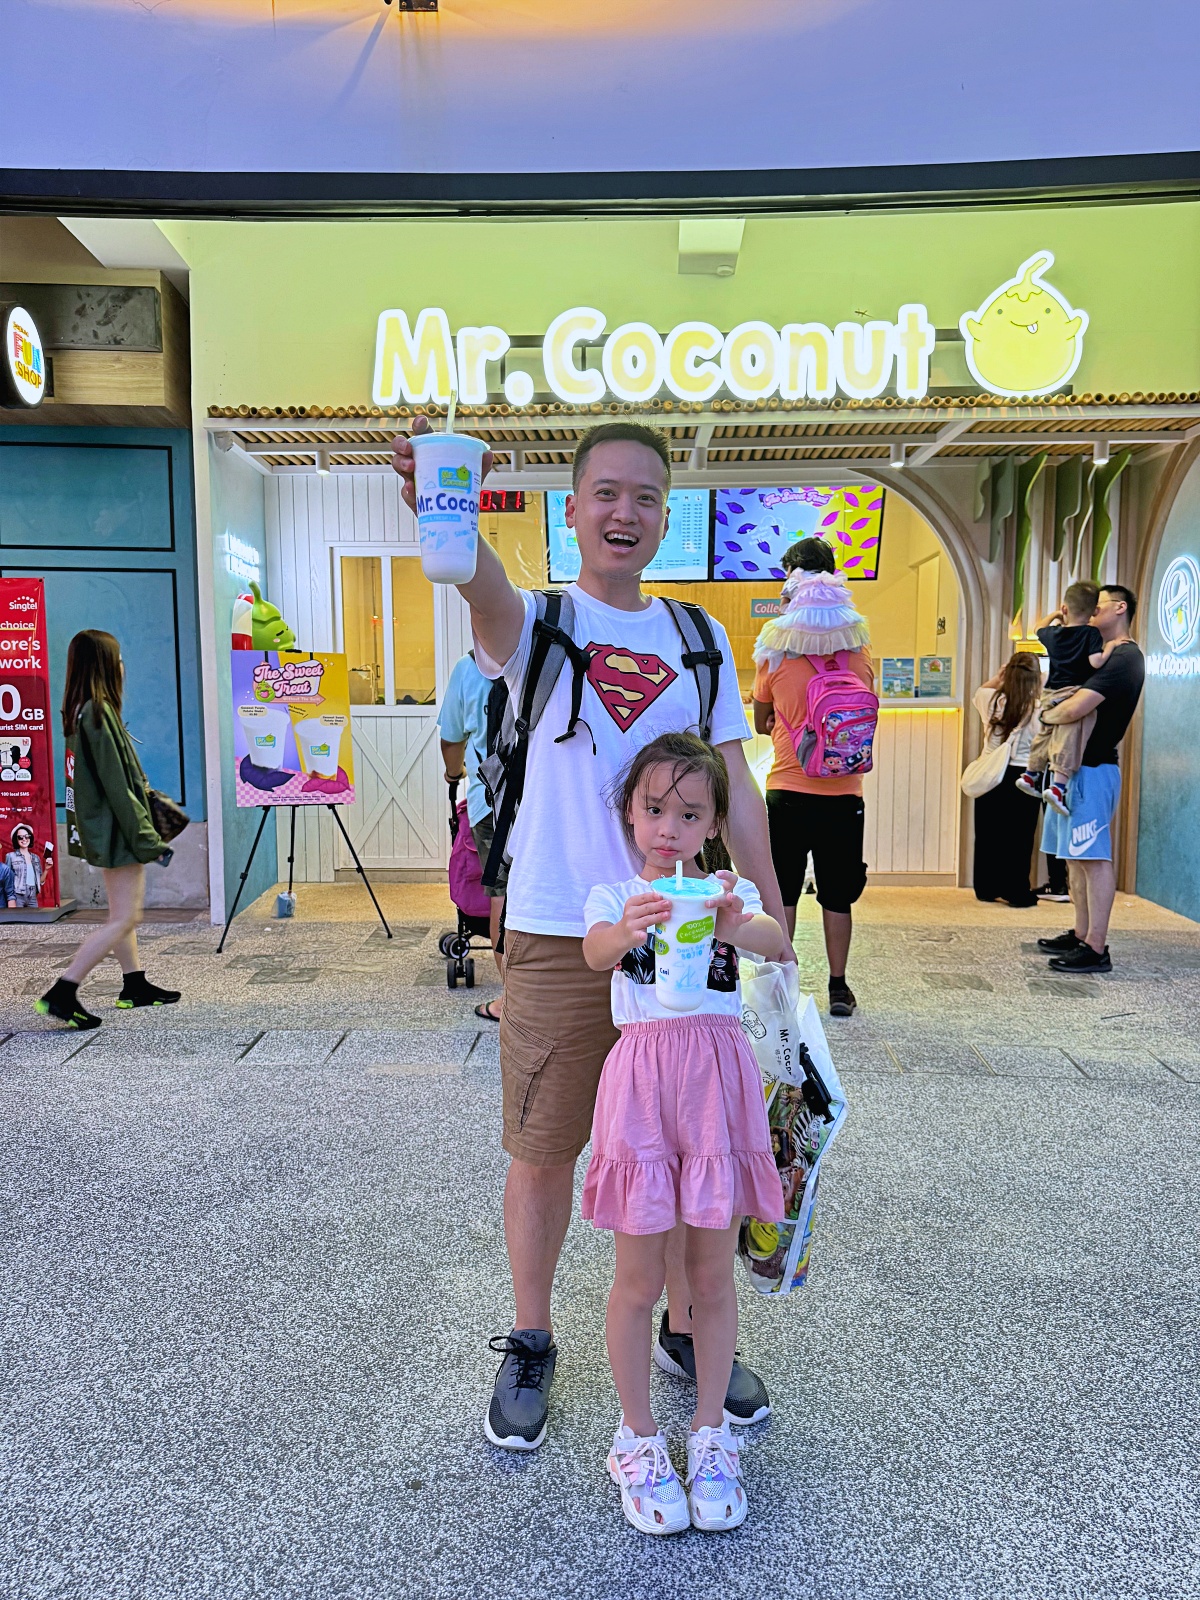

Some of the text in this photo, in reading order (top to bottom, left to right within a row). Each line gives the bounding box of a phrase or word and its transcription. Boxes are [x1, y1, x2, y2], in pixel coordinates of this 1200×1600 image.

[13, 332, 41, 373] FUN
[373, 304, 936, 406] Mr. Coconut
[15, 361, 42, 388] SHOP
[417, 495, 433, 513] Mr.
[9, 602, 38, 612] Singtel
[0, 621, 35, 629] choice
[254, 662, 324, 683] The Sweet
[273, 680, 311, 698] Treat
[1072, 818, 1098, 844] NIKE
[779, 1028, 790, 1048] Mr.
[519, 1331, 537, 1341] FILA
